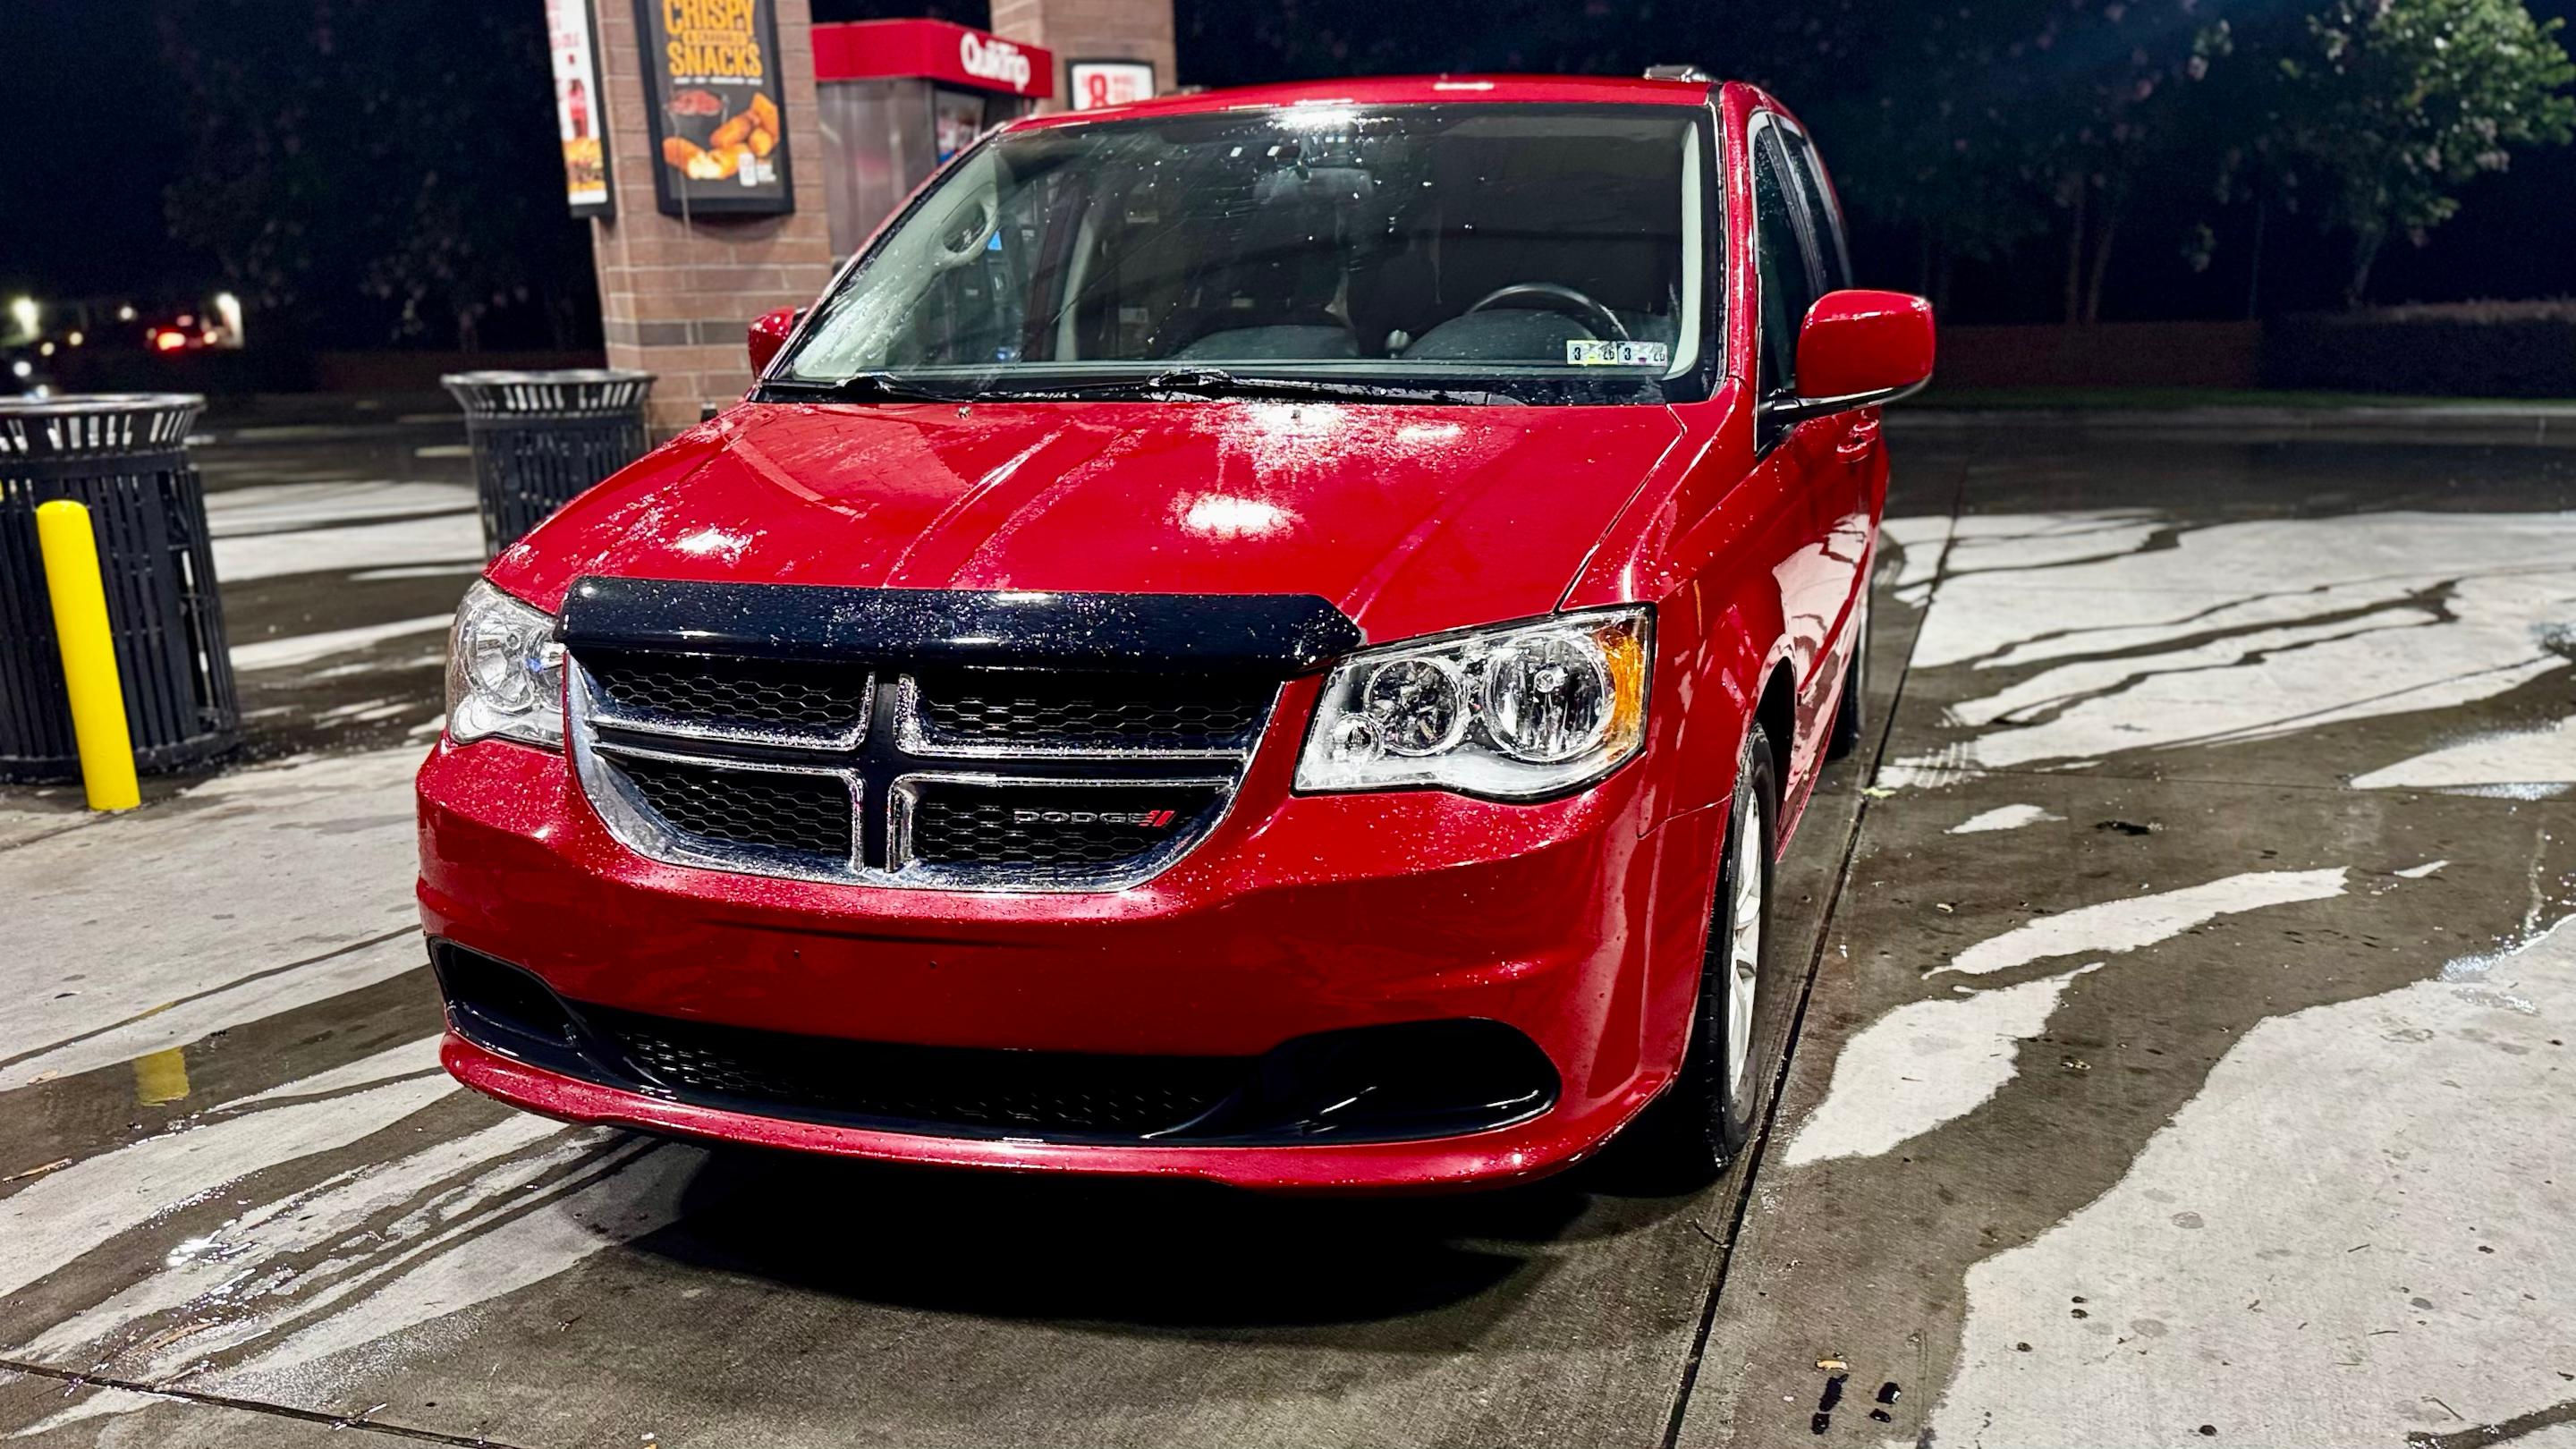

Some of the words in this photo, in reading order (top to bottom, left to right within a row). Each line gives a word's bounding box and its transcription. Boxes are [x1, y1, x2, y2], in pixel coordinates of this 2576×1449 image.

[663, 0, 755, 35] CRISPY
[666, 40, 763, 77] SNACKS
[1574, 347, 1581, 360] 3
[1624, 347, 1631, 360] 3
[1013, 810, 1153, 823] DODGE
